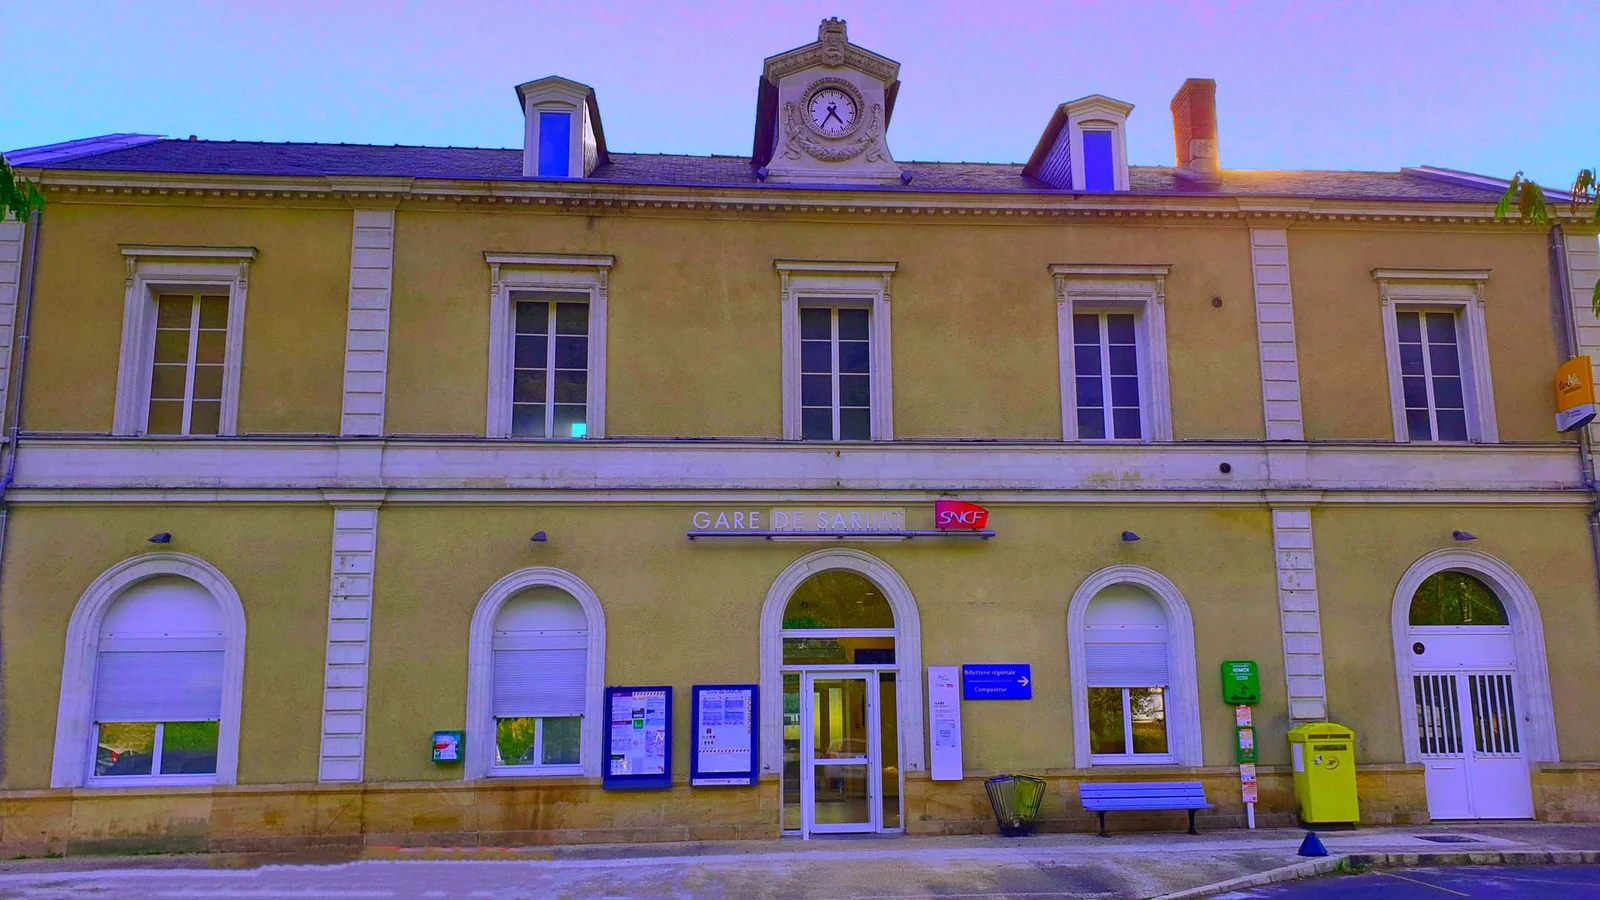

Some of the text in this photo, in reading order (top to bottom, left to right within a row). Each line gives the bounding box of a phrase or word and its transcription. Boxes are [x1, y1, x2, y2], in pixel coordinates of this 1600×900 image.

[692, 511, 903, 529] GARE DE SARLAT
[938, 510, 985, 525] SNCF
